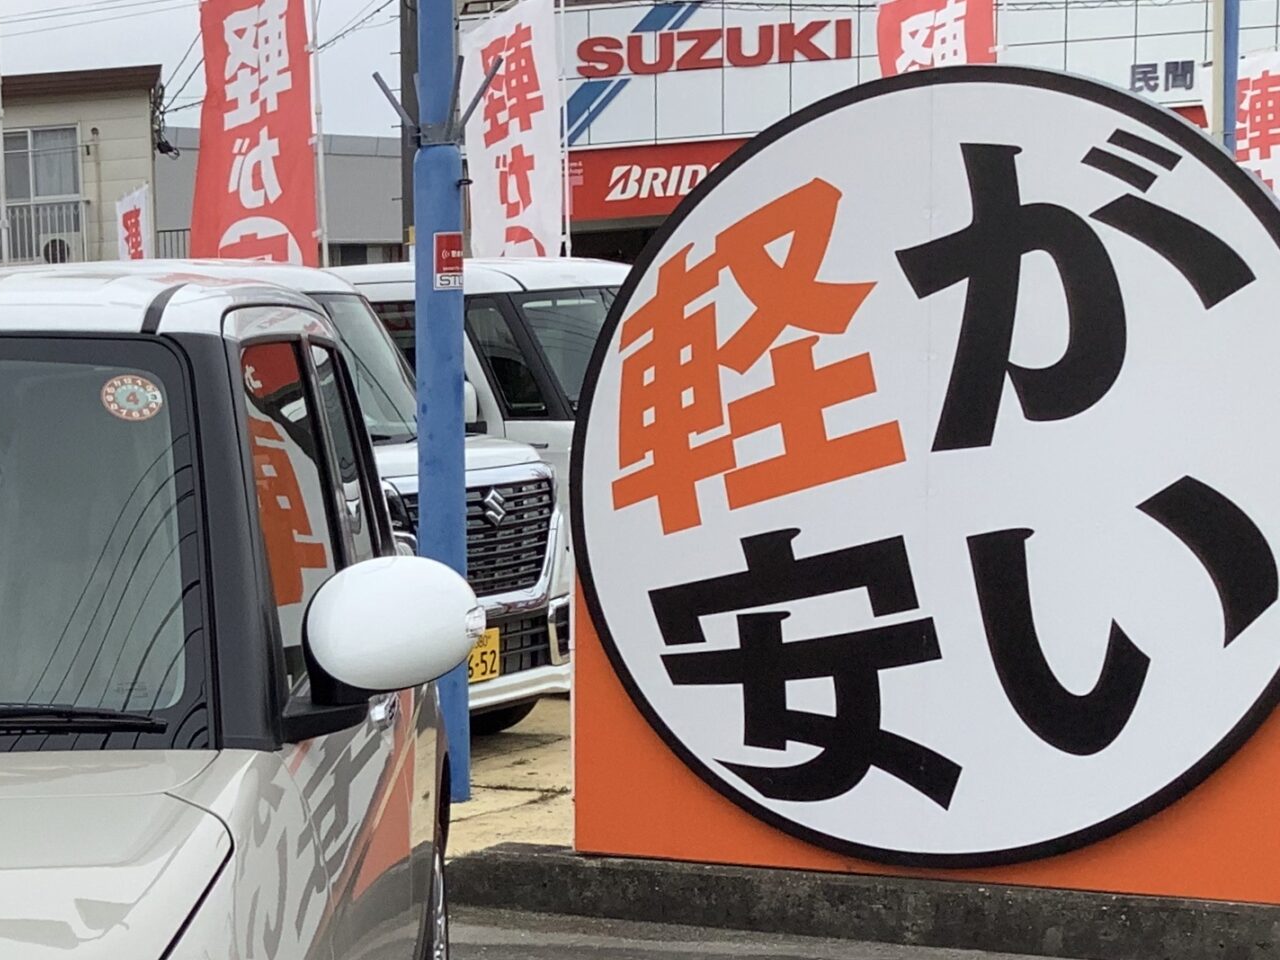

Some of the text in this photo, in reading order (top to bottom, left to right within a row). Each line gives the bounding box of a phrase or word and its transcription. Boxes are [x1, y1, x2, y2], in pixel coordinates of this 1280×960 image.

[576, 18, 853, 79] SUZUKI
[1130, 60, 1195, 93] 民間
[604, 162, 720, 202] BRID
[611, 128, 1256, 536] 軽が
[647, 475, 1280, 811] 安い
